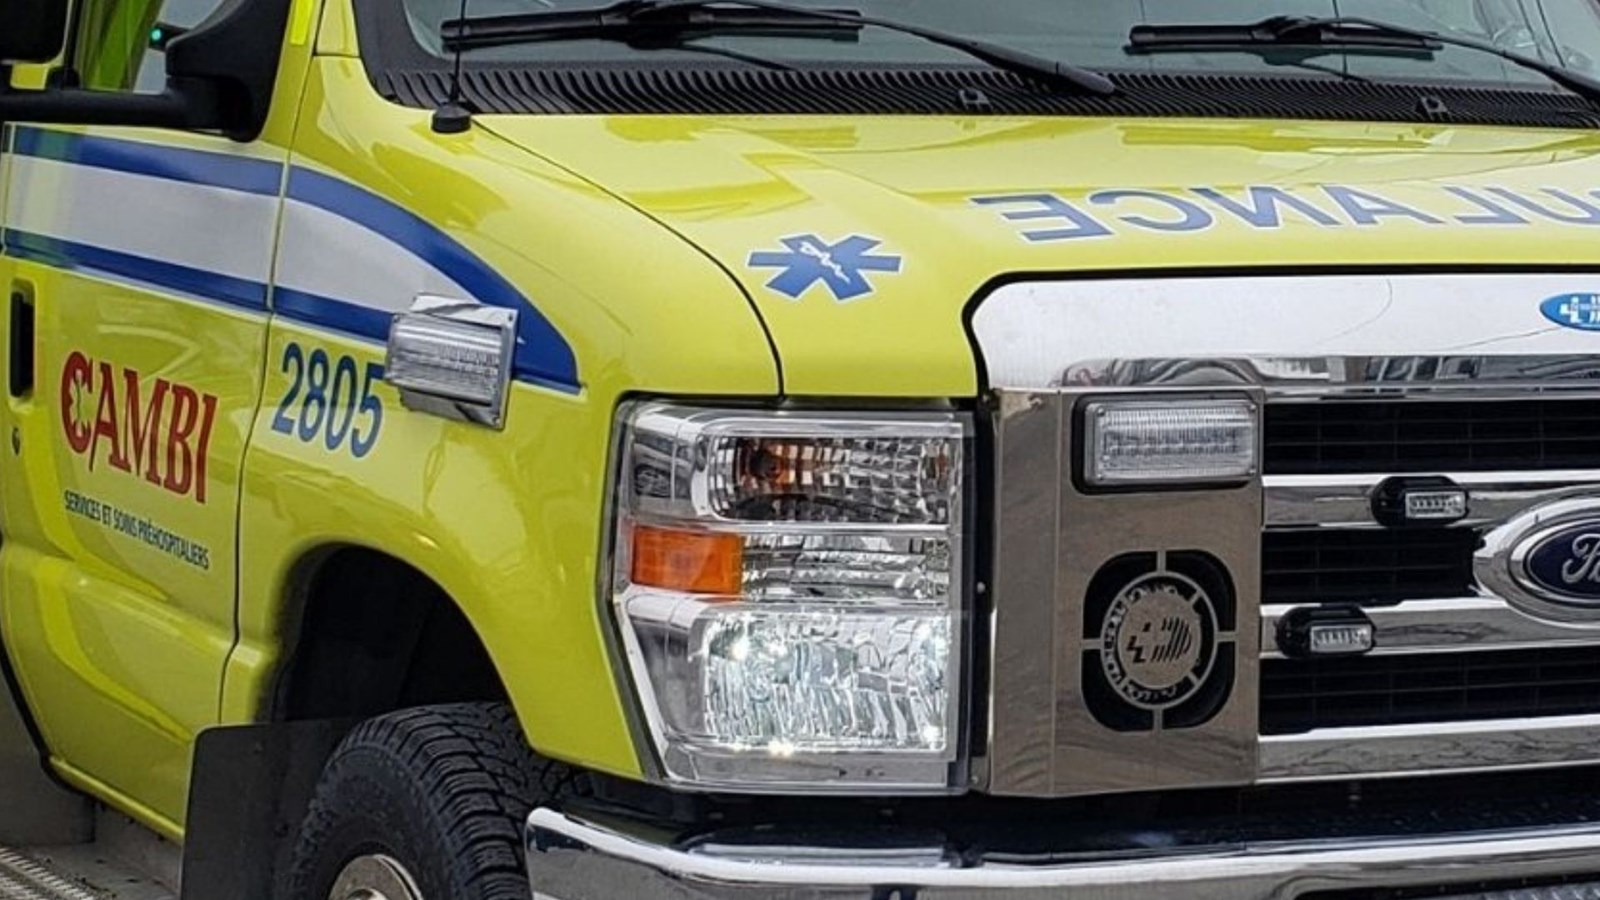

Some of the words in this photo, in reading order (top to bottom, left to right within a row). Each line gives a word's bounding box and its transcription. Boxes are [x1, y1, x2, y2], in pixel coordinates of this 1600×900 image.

[62, 351, 216, 503] CAMBI
[271, 342, 384, 458] 2805
[65, 490, 101, 521] SERVICES
[102, 505, 111, 525] ET
[113, 509, 137, 537] SOINS
